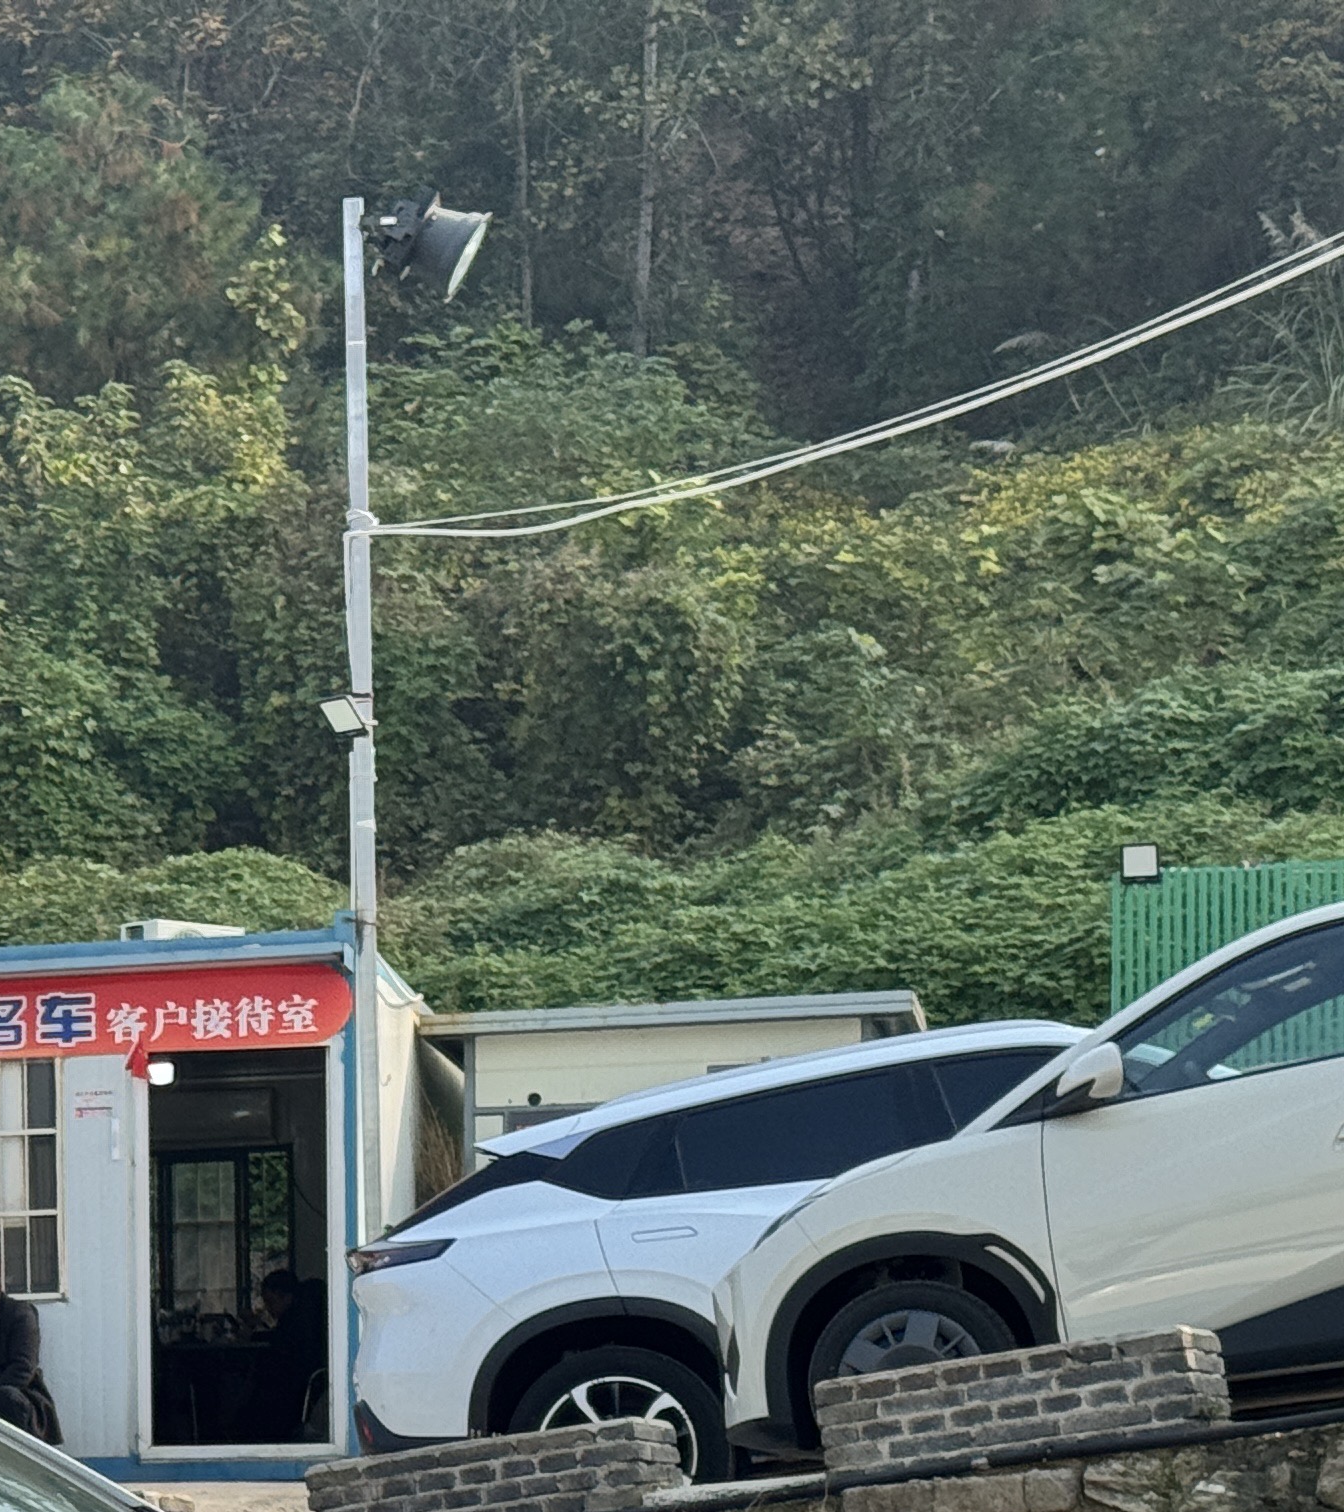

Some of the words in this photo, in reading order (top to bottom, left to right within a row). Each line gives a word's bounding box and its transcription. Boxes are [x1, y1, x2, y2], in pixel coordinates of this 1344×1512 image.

[106, 994, 319, 1044] 客户接待室
